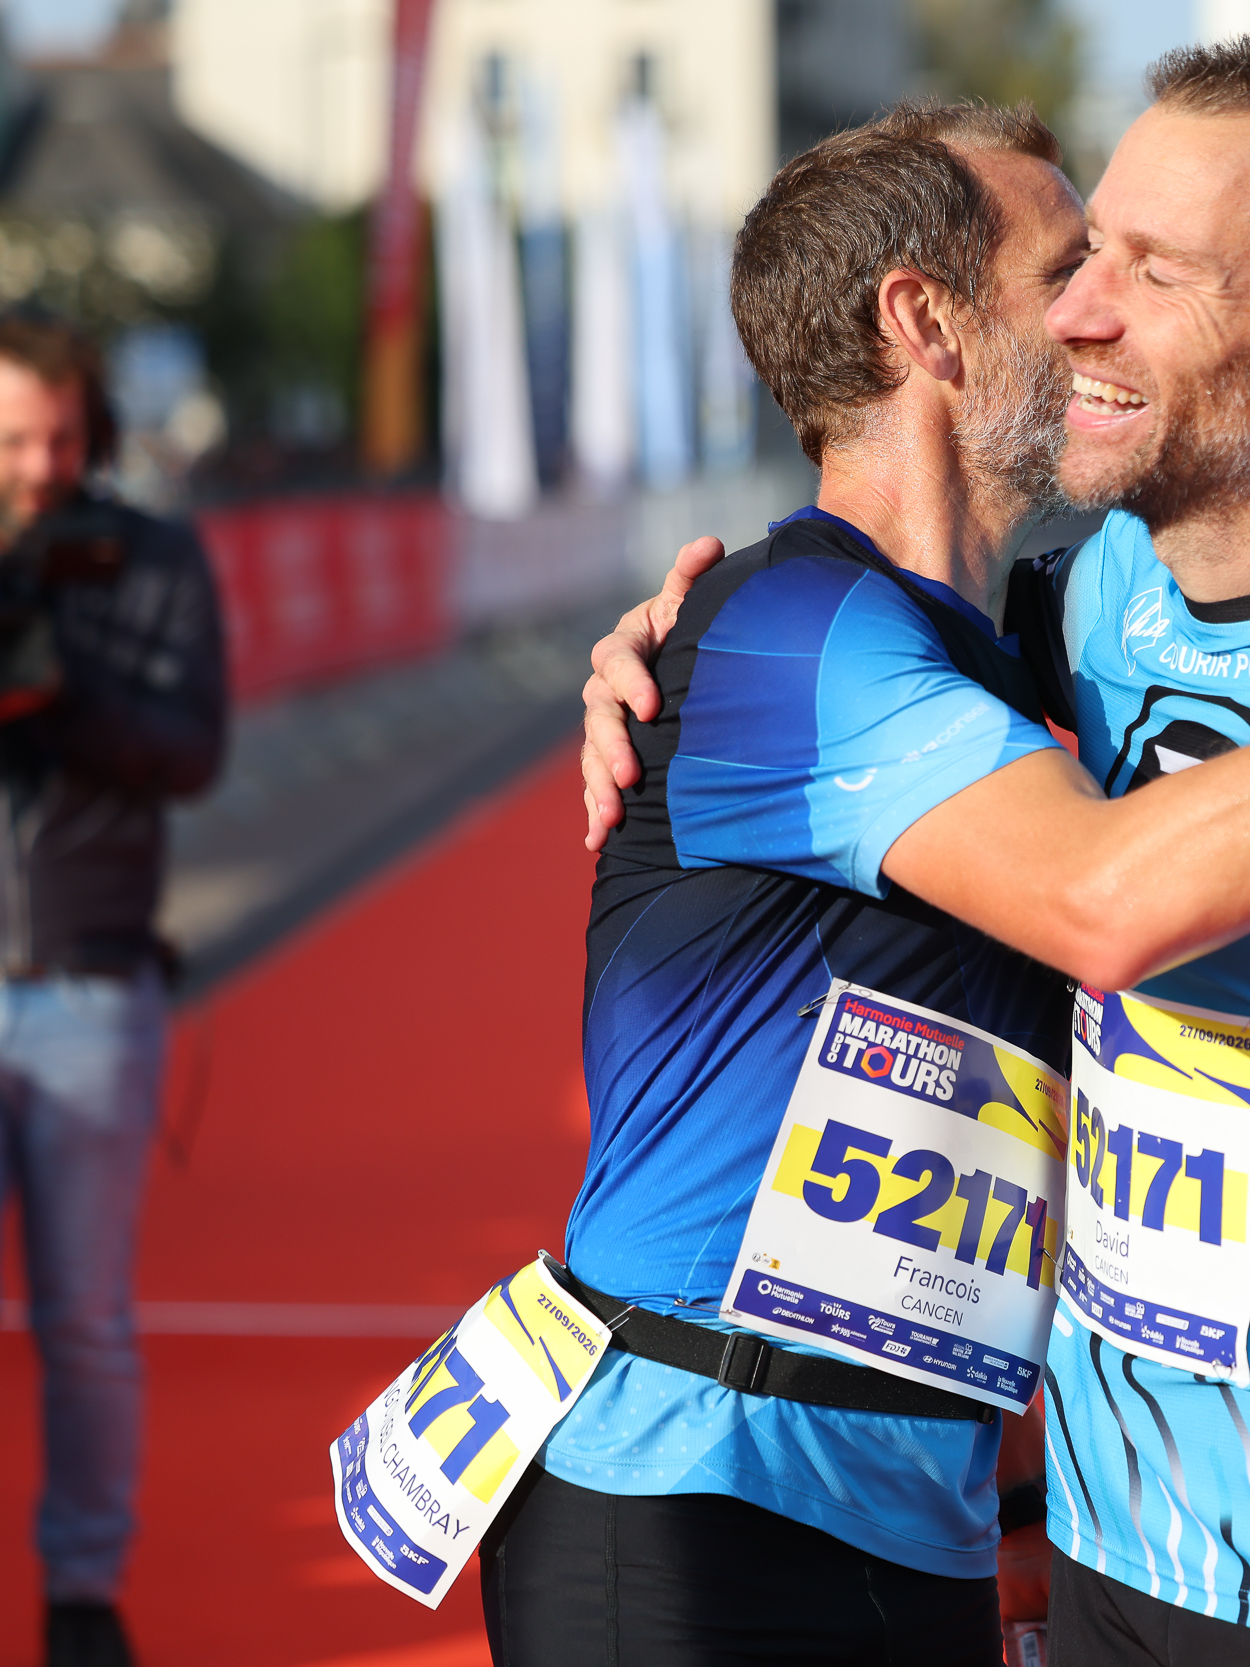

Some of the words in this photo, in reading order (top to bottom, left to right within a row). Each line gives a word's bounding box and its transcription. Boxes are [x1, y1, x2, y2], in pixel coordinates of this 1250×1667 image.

[1159, 641, 1231, 678] COURIR
[838, 1012, 962, 1071] MARATHON
[844, 998, 914, 1032] Harmonie
[914, 1021, 965, 1050] Mutuelle
[827, 1032, 844, 1064] DUO
[843, 1036, 957, 1101] TOURS
[1075, 1086, 1225, 1246] 52171
[802, 1118, 1048, 1291] 52171
[1096, 1220, 1129, 1258] David
[893, 1256, 981, 1304] Francois
[1095, 1255, 1129, 1285] CANCEN
[771, 1291, 799, 1305] Mutuelle
[772, 1284, 804, 1300] Harmonie
[537, 1293, 598, 1357] 27/09/2026
[820, 1303, 851, 1320] TOURS
[901, 1295, 964, 1327] CANCEN
[933, 1358, 957, 1370] HYUNDAI
[1017, 1366, 1032, 1378] SKF
[383, 1443, 470, 1540] CHAMBRAY
[400, 1543, 430, 1565] SKF
